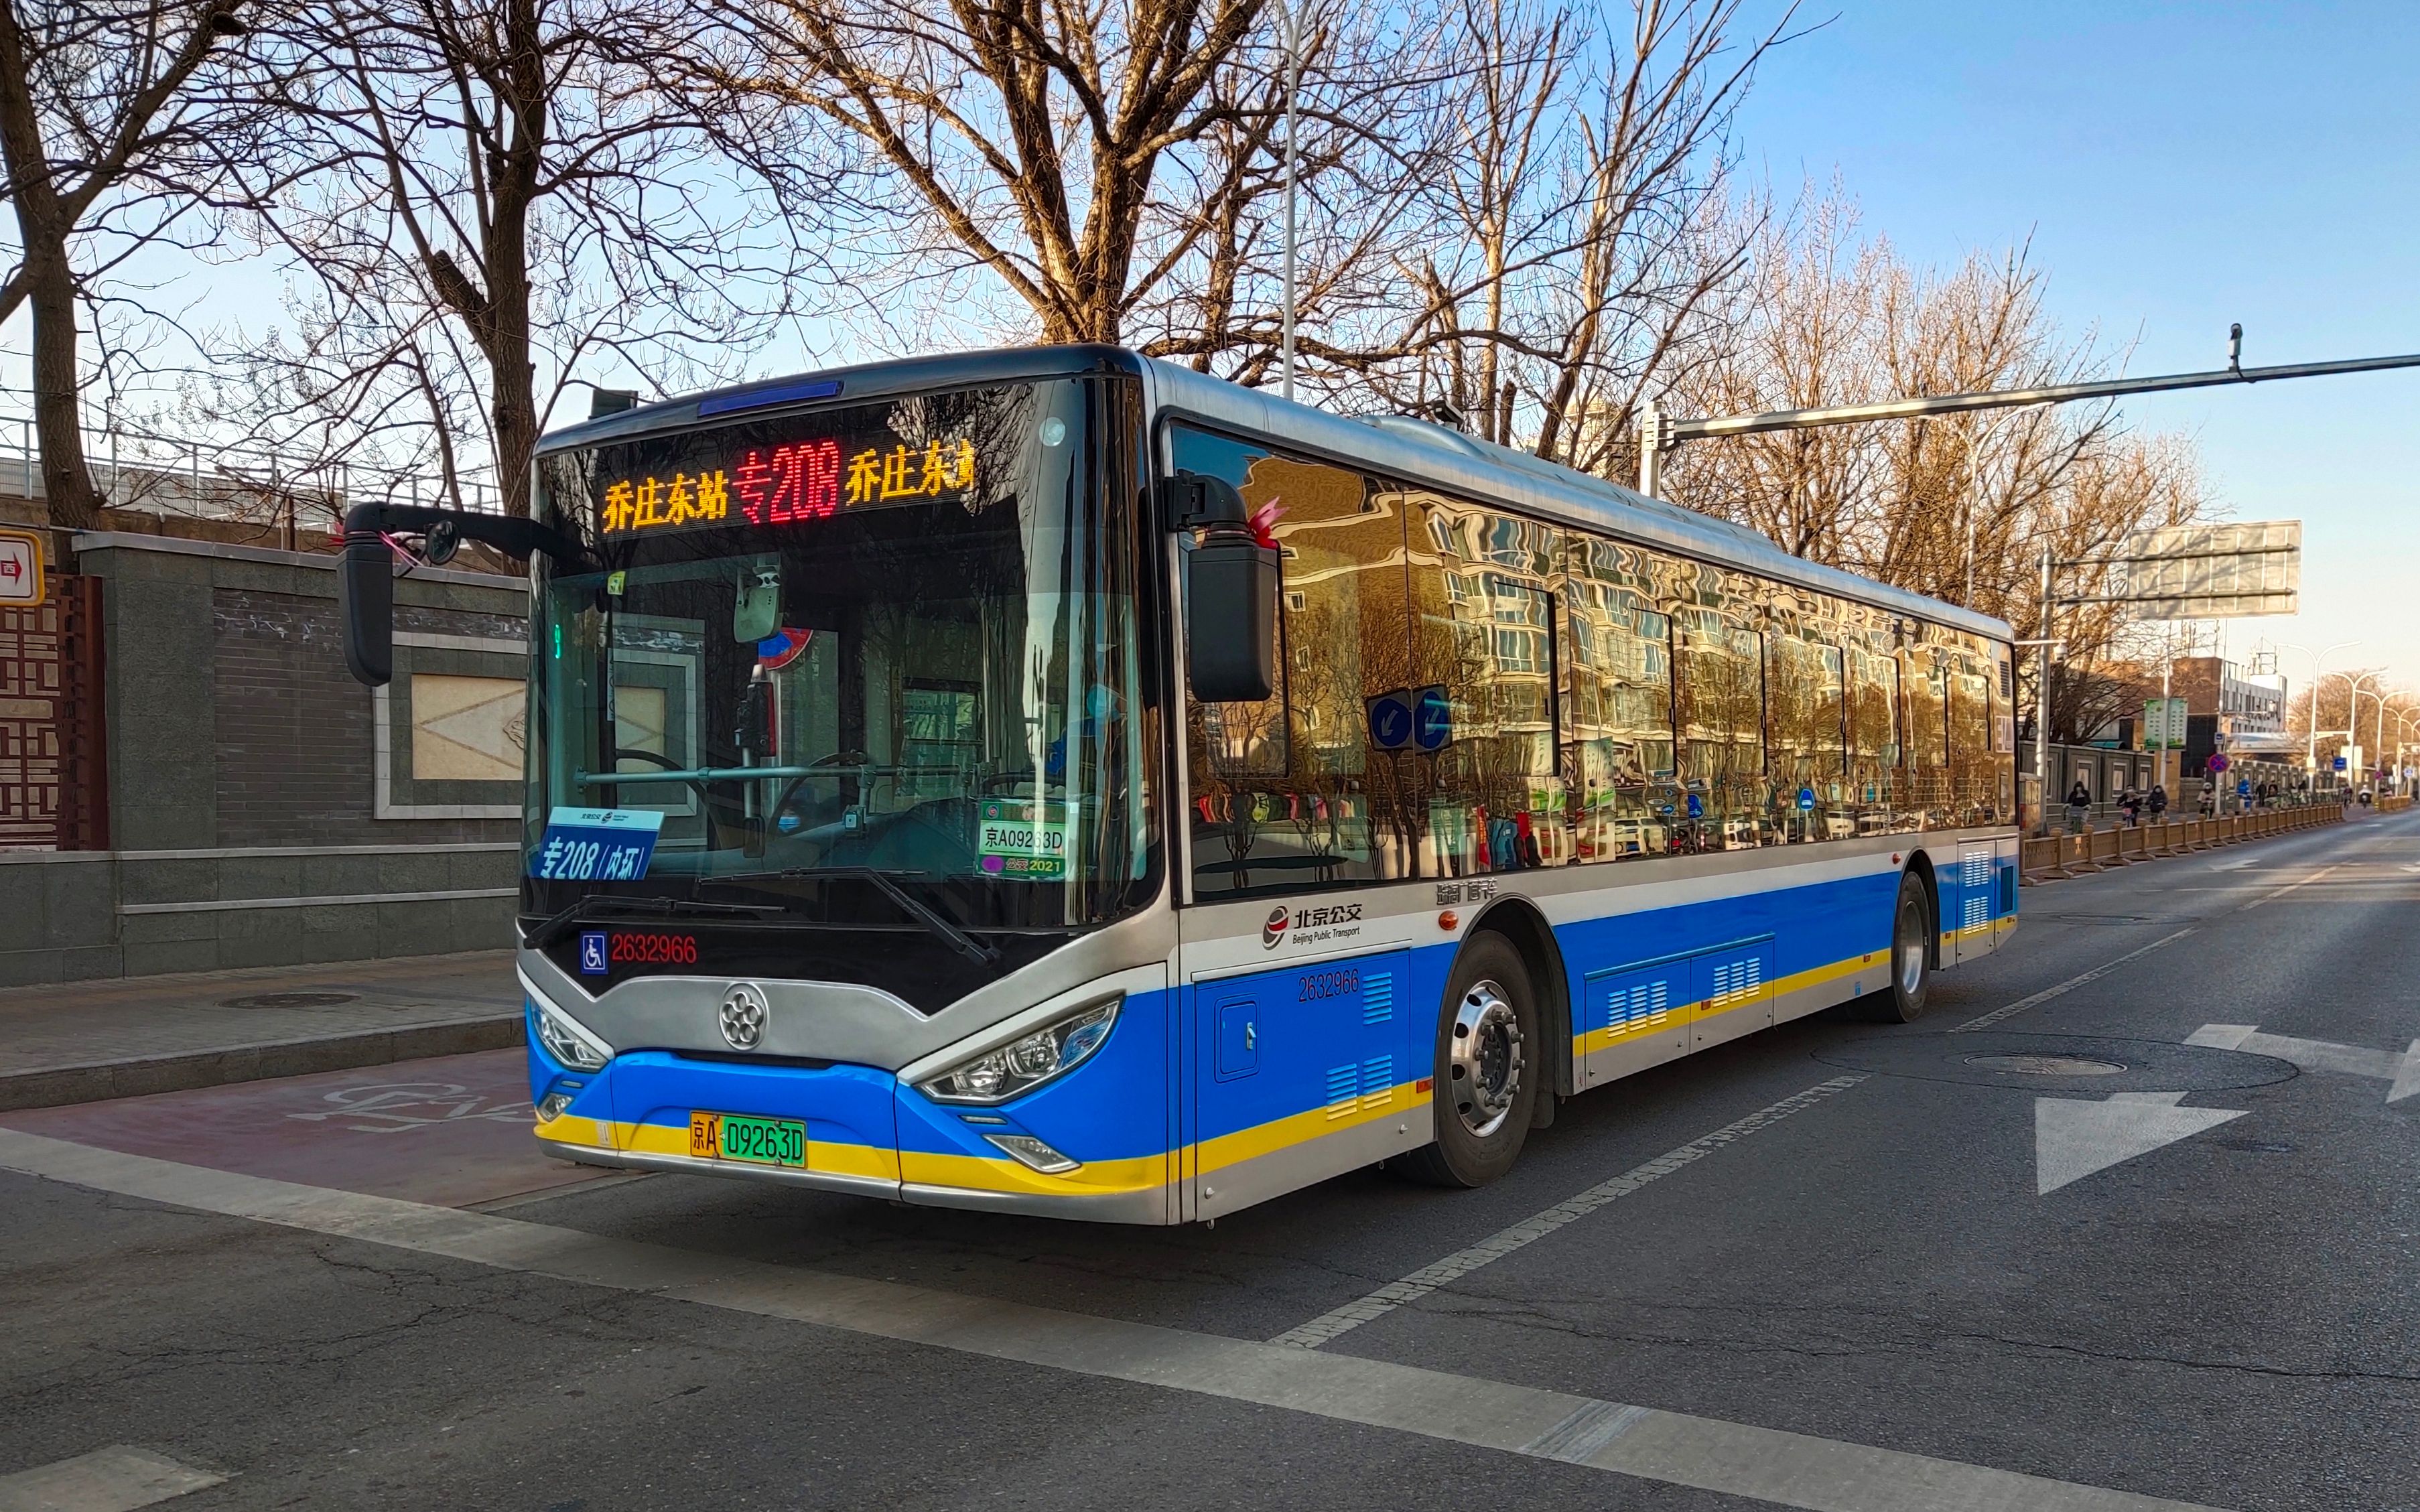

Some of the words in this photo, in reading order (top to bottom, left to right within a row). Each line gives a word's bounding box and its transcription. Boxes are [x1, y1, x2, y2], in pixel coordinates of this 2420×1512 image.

[602, 470, 728, 533] 乔庄东站
[732, 441, 839, 524] 专208
[1294, 903, 1363, 929] 北京公交
[611, 933, 697, 963] 2632966
[1292, 933, 1313, 946] Beijing
[1314, 929, 1332, 941] Public
[1333, 926, 1361, 939] Transport
[1298, 968, 1359, 1003] 2632966
